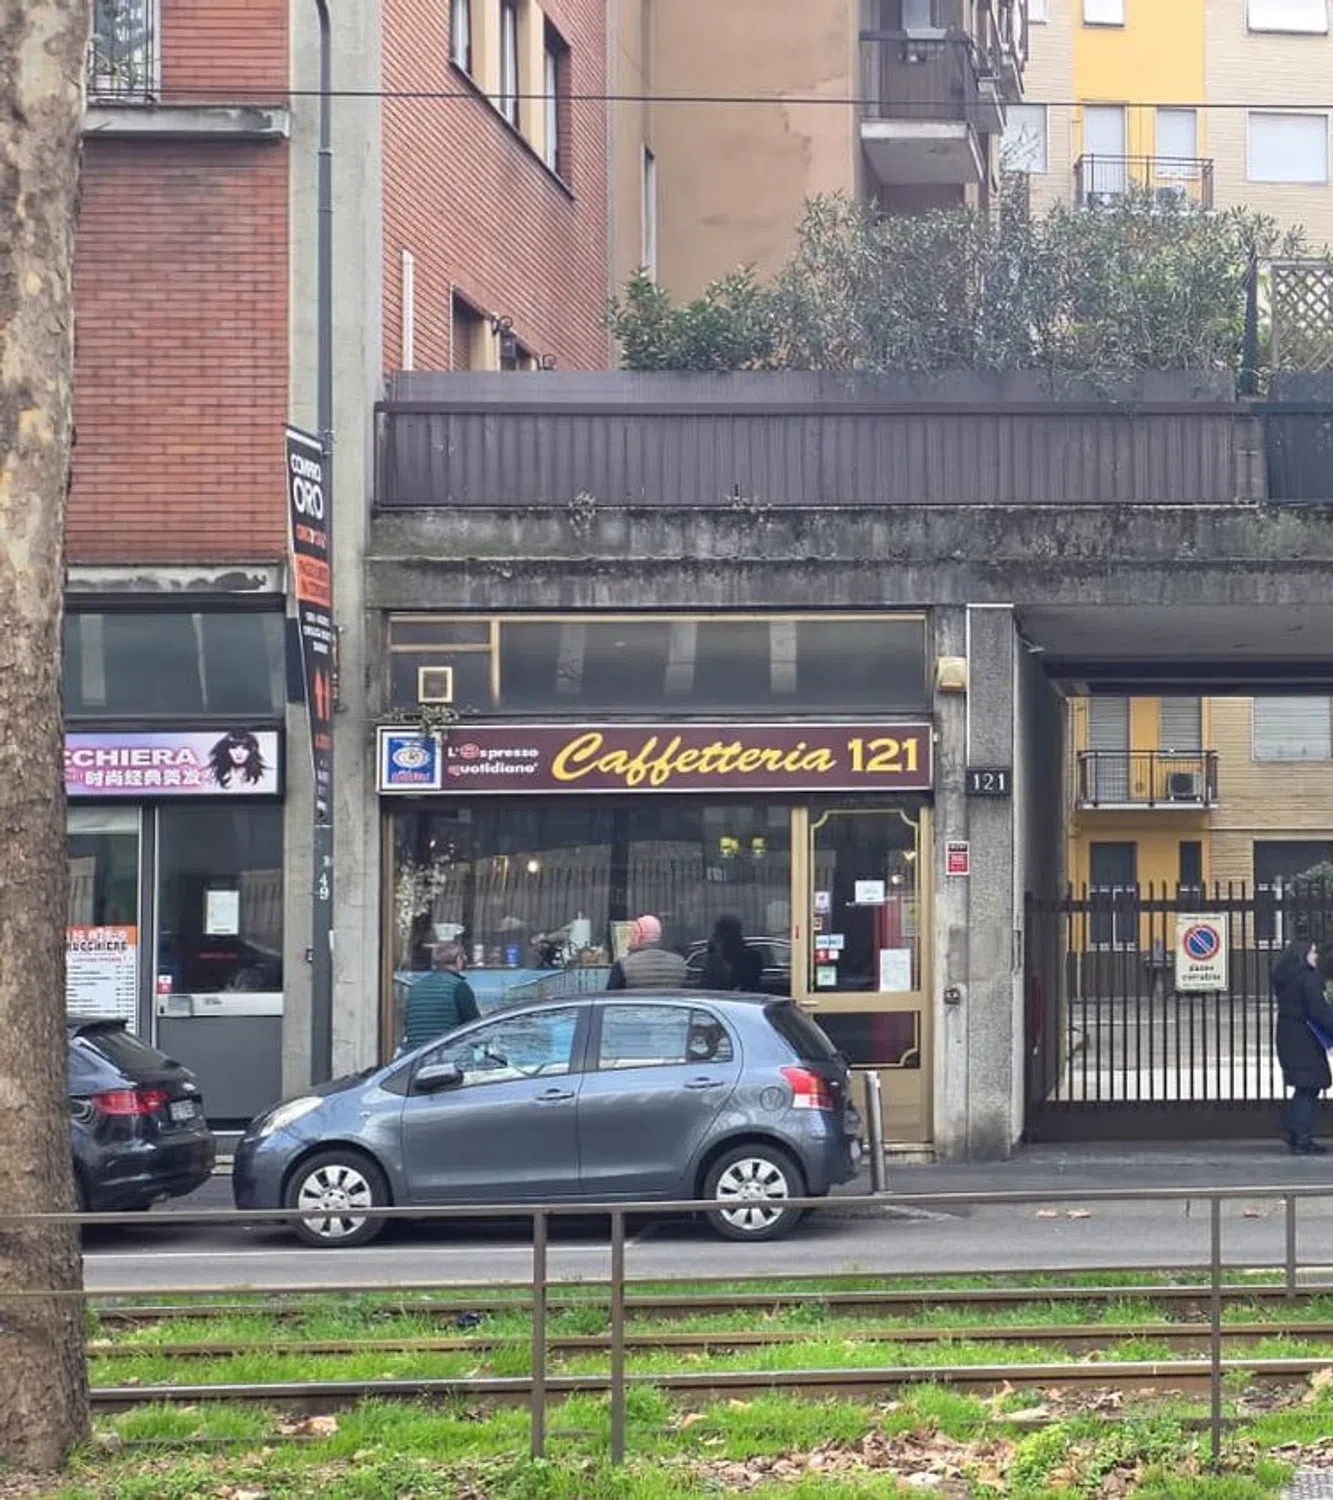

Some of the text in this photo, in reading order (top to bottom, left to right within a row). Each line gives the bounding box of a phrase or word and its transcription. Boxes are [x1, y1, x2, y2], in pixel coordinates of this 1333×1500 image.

[293, 476, 324, 520] ORO
[552, 732, 919, 786] Caffetteria 121
[973, 772, 1005, 790] 121
